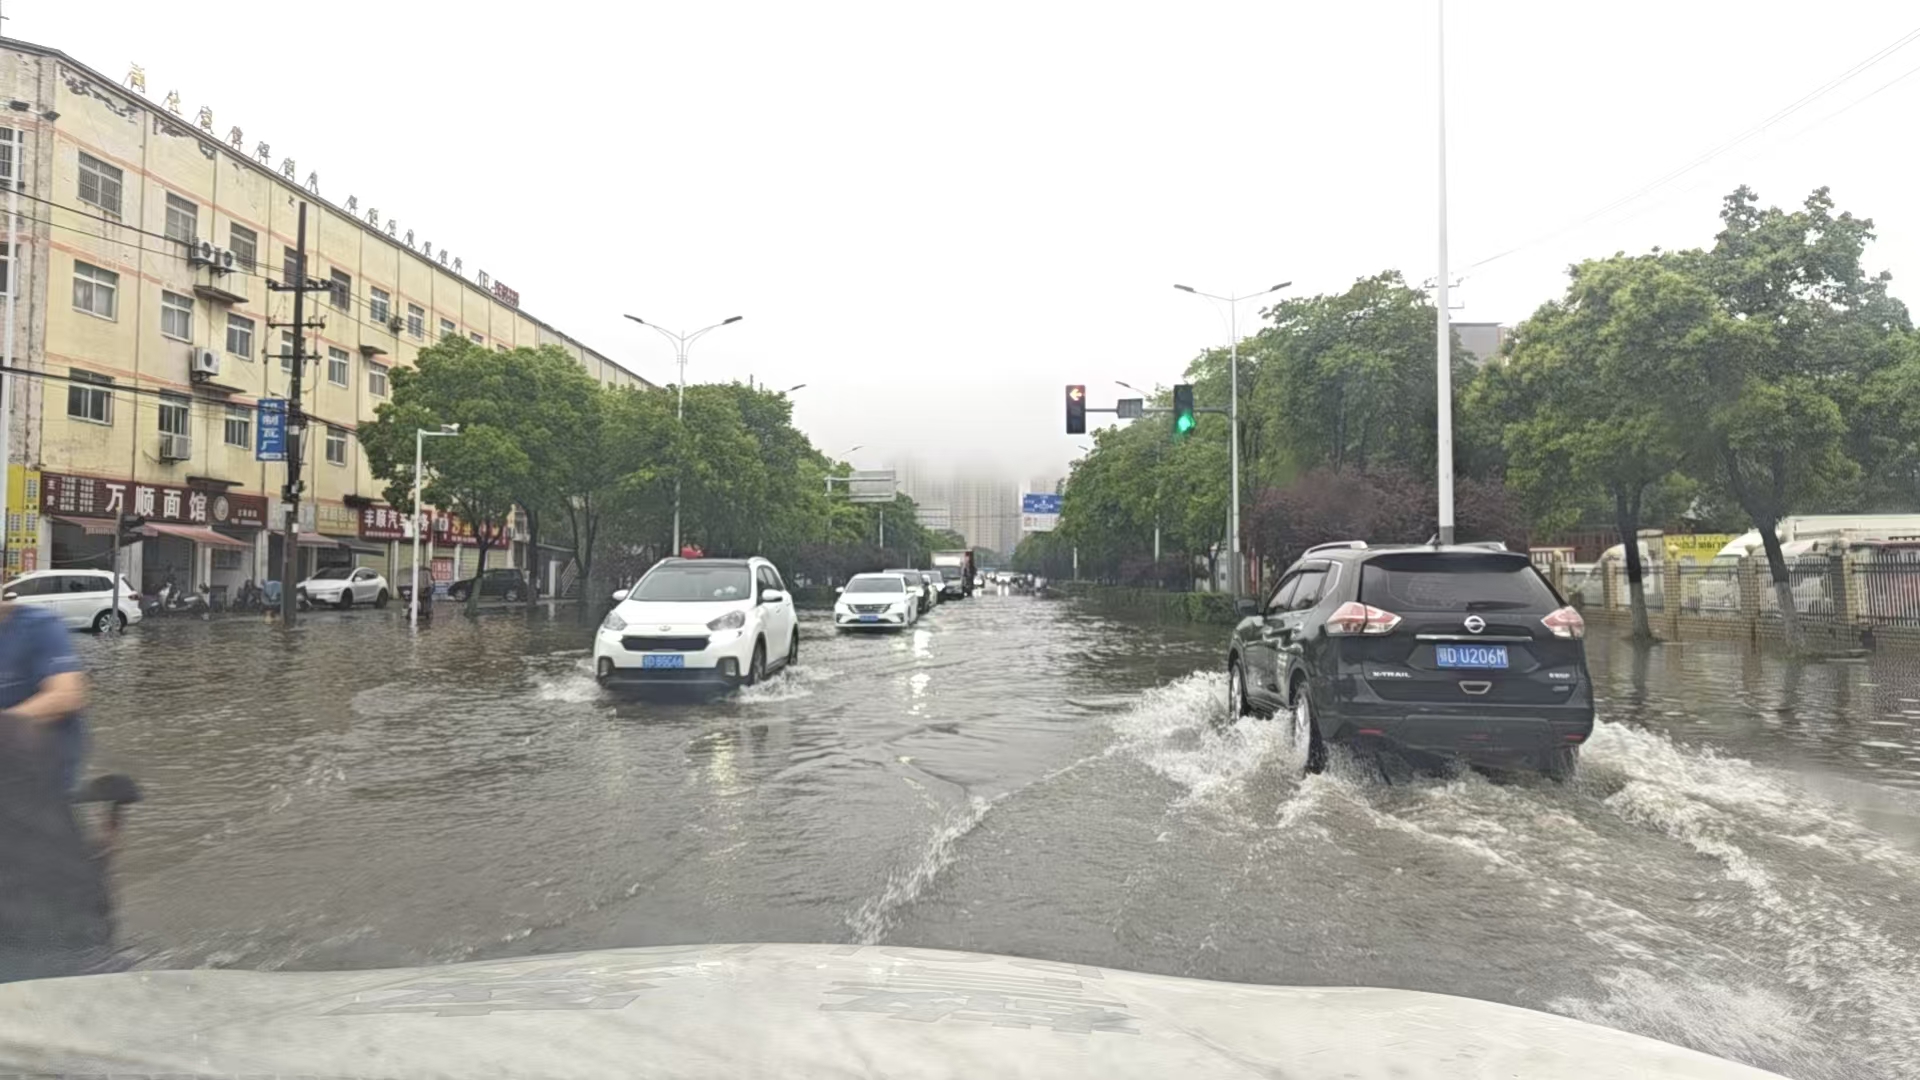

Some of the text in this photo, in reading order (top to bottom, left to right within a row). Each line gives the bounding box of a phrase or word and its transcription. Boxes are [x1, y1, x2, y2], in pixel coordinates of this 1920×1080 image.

[104, 483, 208, 521] 万顺面馆
[364, 508, 429, 532] 丰顺汽车务
